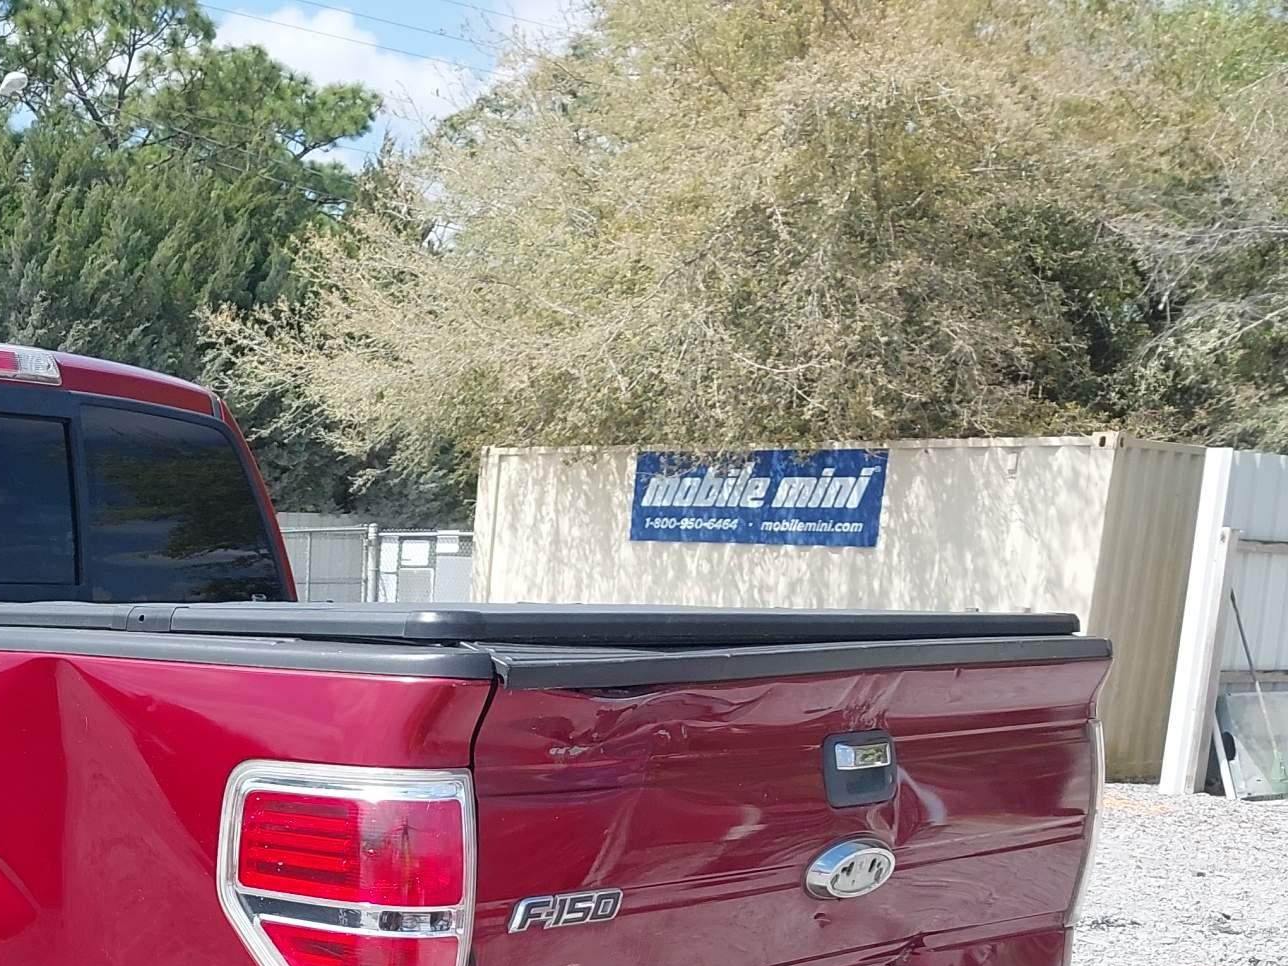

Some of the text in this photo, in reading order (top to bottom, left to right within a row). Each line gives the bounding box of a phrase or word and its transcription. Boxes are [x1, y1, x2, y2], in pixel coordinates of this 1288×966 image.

[641, 462, 875, 508] mobile mini
[645, 517, 864, 533] 1-800-950-6464 mobilemini.com
[508, 888, 624, 934] F-150
